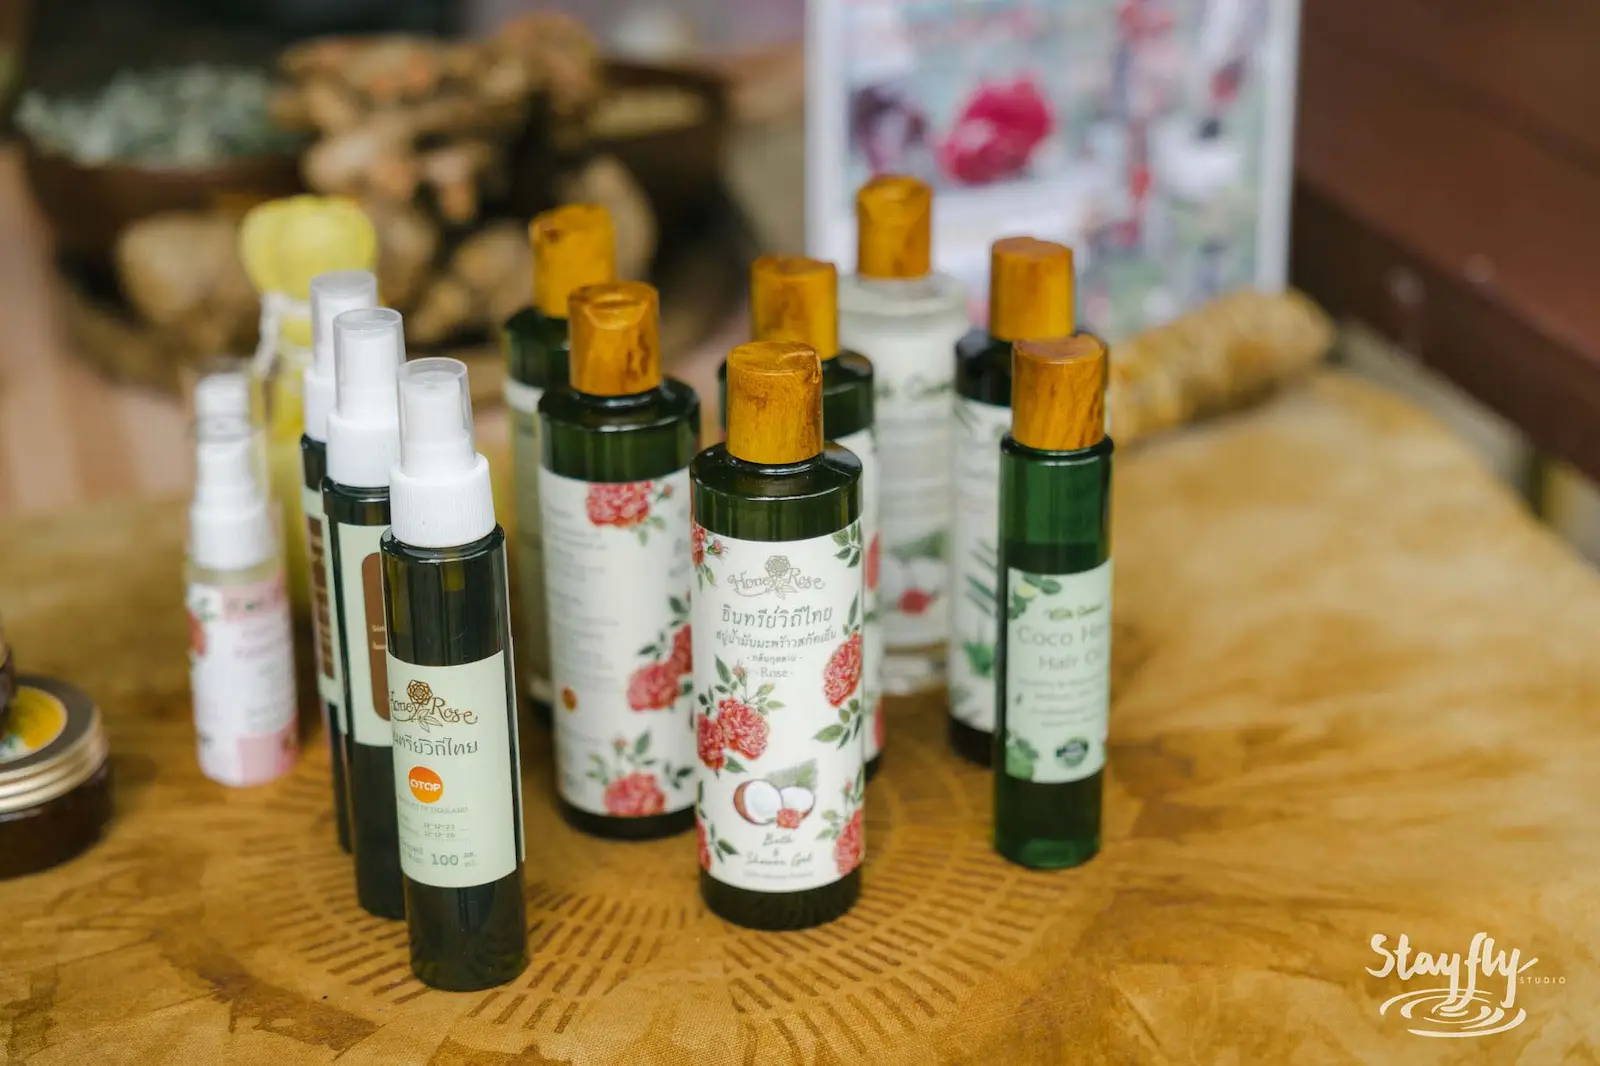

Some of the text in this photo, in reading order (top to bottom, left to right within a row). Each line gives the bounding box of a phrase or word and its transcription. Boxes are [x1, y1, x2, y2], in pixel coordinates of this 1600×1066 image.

[786, 567, 826, 590] Rose
[1017, 625, 1073, 646] Coco
[431, 696, 478, 725] Rose
[410, 778, 441, 792] OTOP
[431, 853, 459, 866] 100
